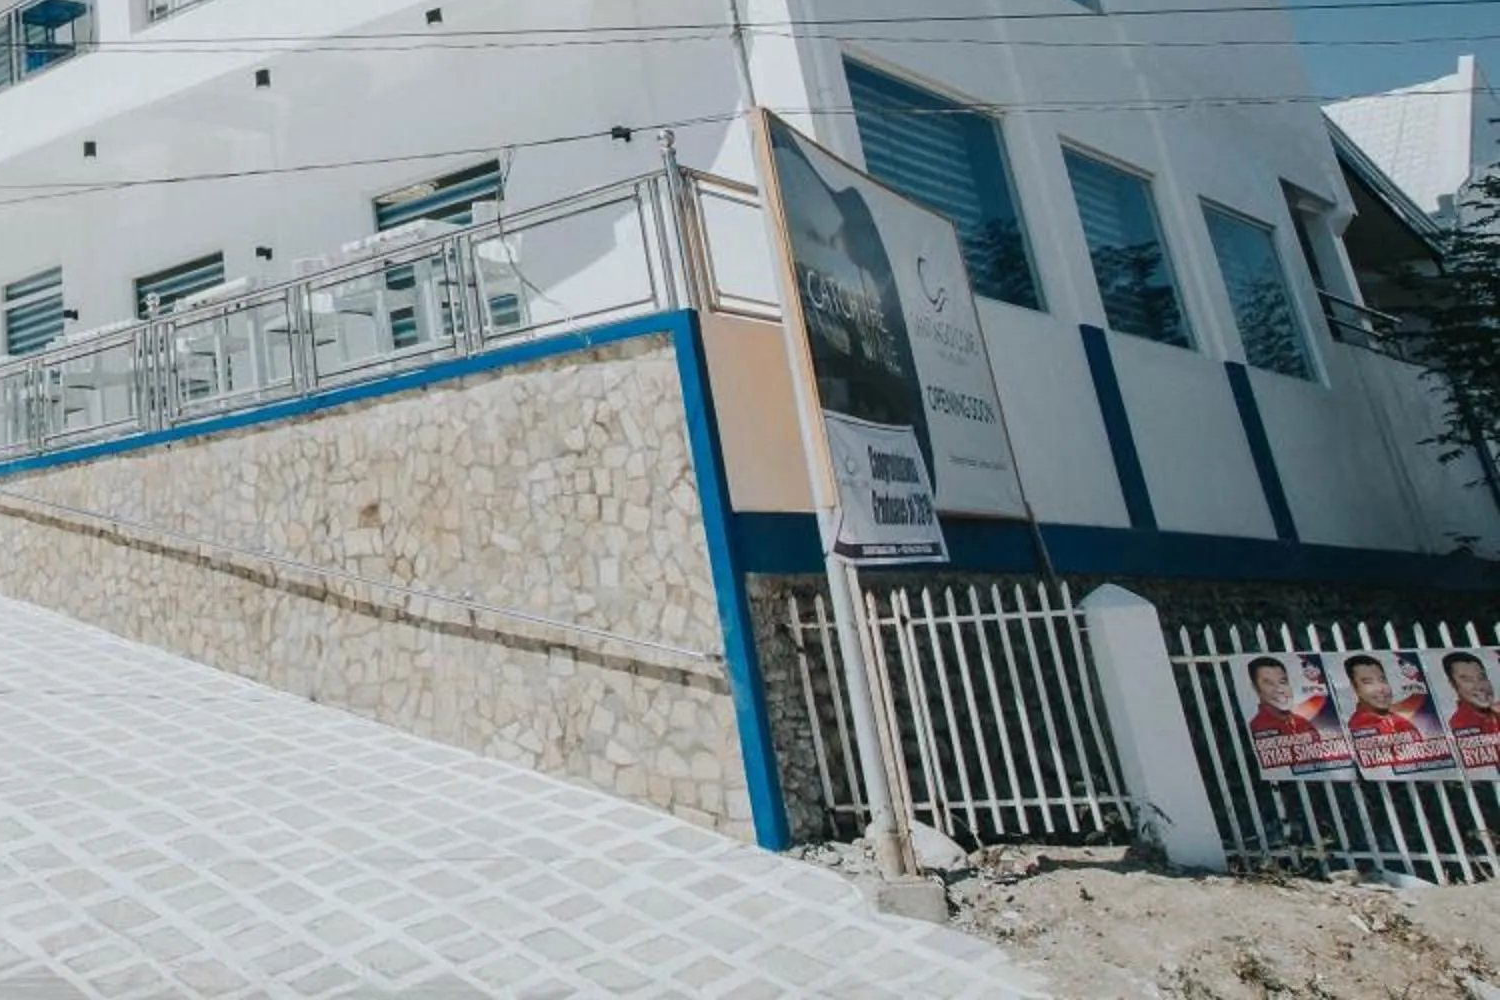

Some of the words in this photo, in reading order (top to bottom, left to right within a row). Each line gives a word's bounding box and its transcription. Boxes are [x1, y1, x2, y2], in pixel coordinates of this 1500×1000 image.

[1261, 747, 1293, 767] RYAN
[1360, 747, 1393, 767] RYAN
[1462, 745, 1499, 767] RYAN
